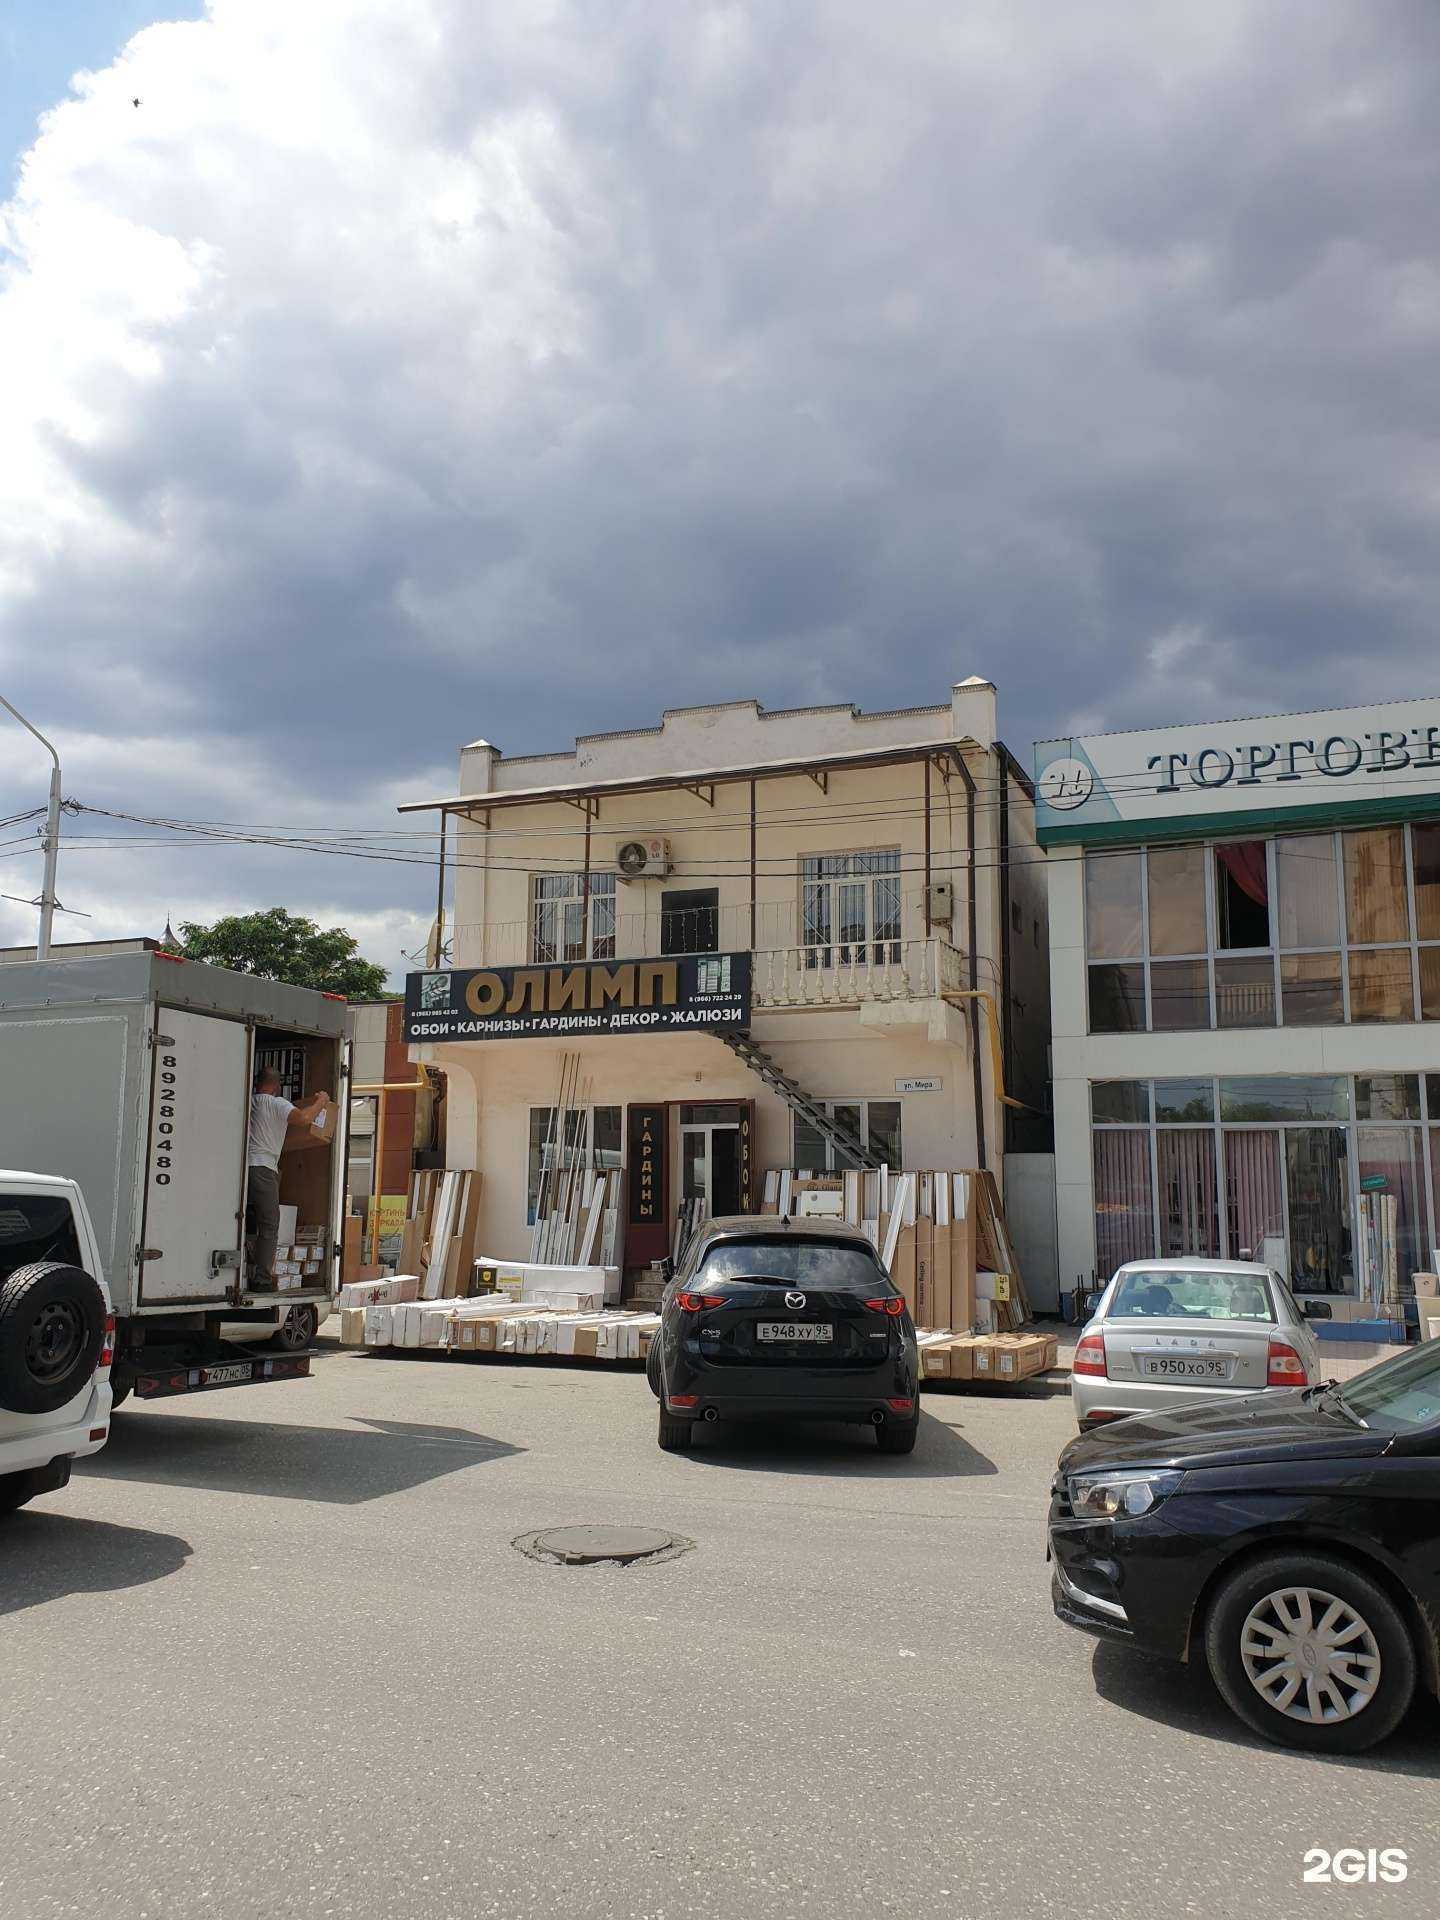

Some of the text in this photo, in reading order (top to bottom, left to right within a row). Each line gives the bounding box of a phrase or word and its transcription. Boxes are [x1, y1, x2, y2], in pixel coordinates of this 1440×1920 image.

[465, 962, 678, 1016] ОЛИМП
[410, 1008, 742, 1036] ОБОИ КАРНИЗЫ ГАРДИНЫ ДЕКОР ЖАЛЮЗИ
[914, 1081, 933, 1089] Мира
[640, 1117, 653, 1216] ГАРДИНЫ
[1155, 1338, 1216, 1348] LADA
